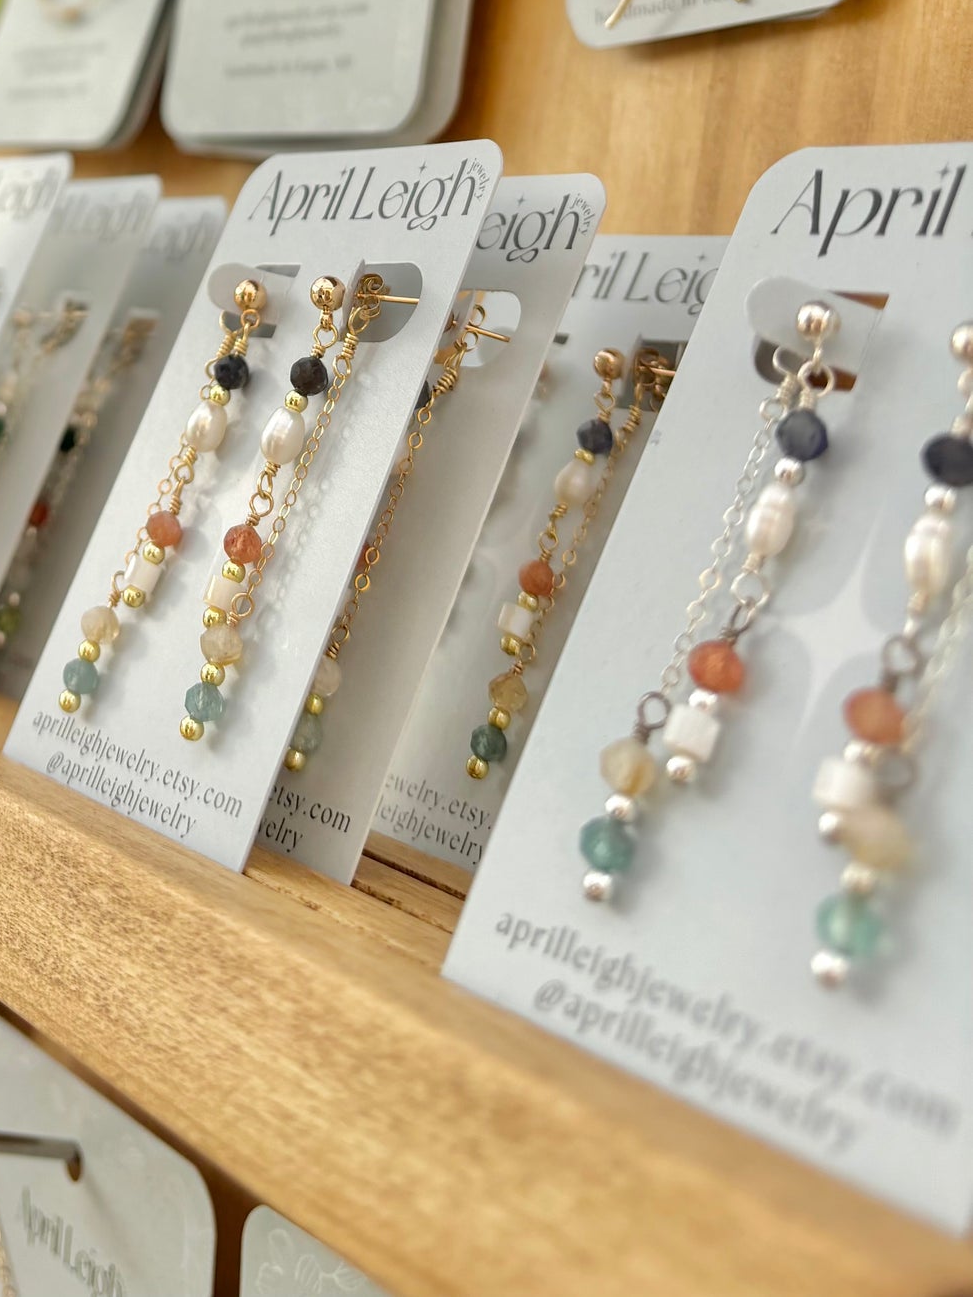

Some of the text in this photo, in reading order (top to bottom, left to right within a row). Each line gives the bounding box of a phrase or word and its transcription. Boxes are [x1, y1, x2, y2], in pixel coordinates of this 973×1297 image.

[248, 164, 356, 237] April
[349, 158, 478, 231] Leigh
[467, 157, 491, 200] jewelry
[570, 192, 591, 237] jewelry
[770, 163, 968, 259] April
[477, 193, 581, 264] eigh
[572, 251, 719, 316] ril Leig
[31, 708, 244, 819] aprilleighjewelry.etsy.com
[45, 750, 198, 839] @aprilleighjewelry
[375, 794, 483, 866] leighjewelry
